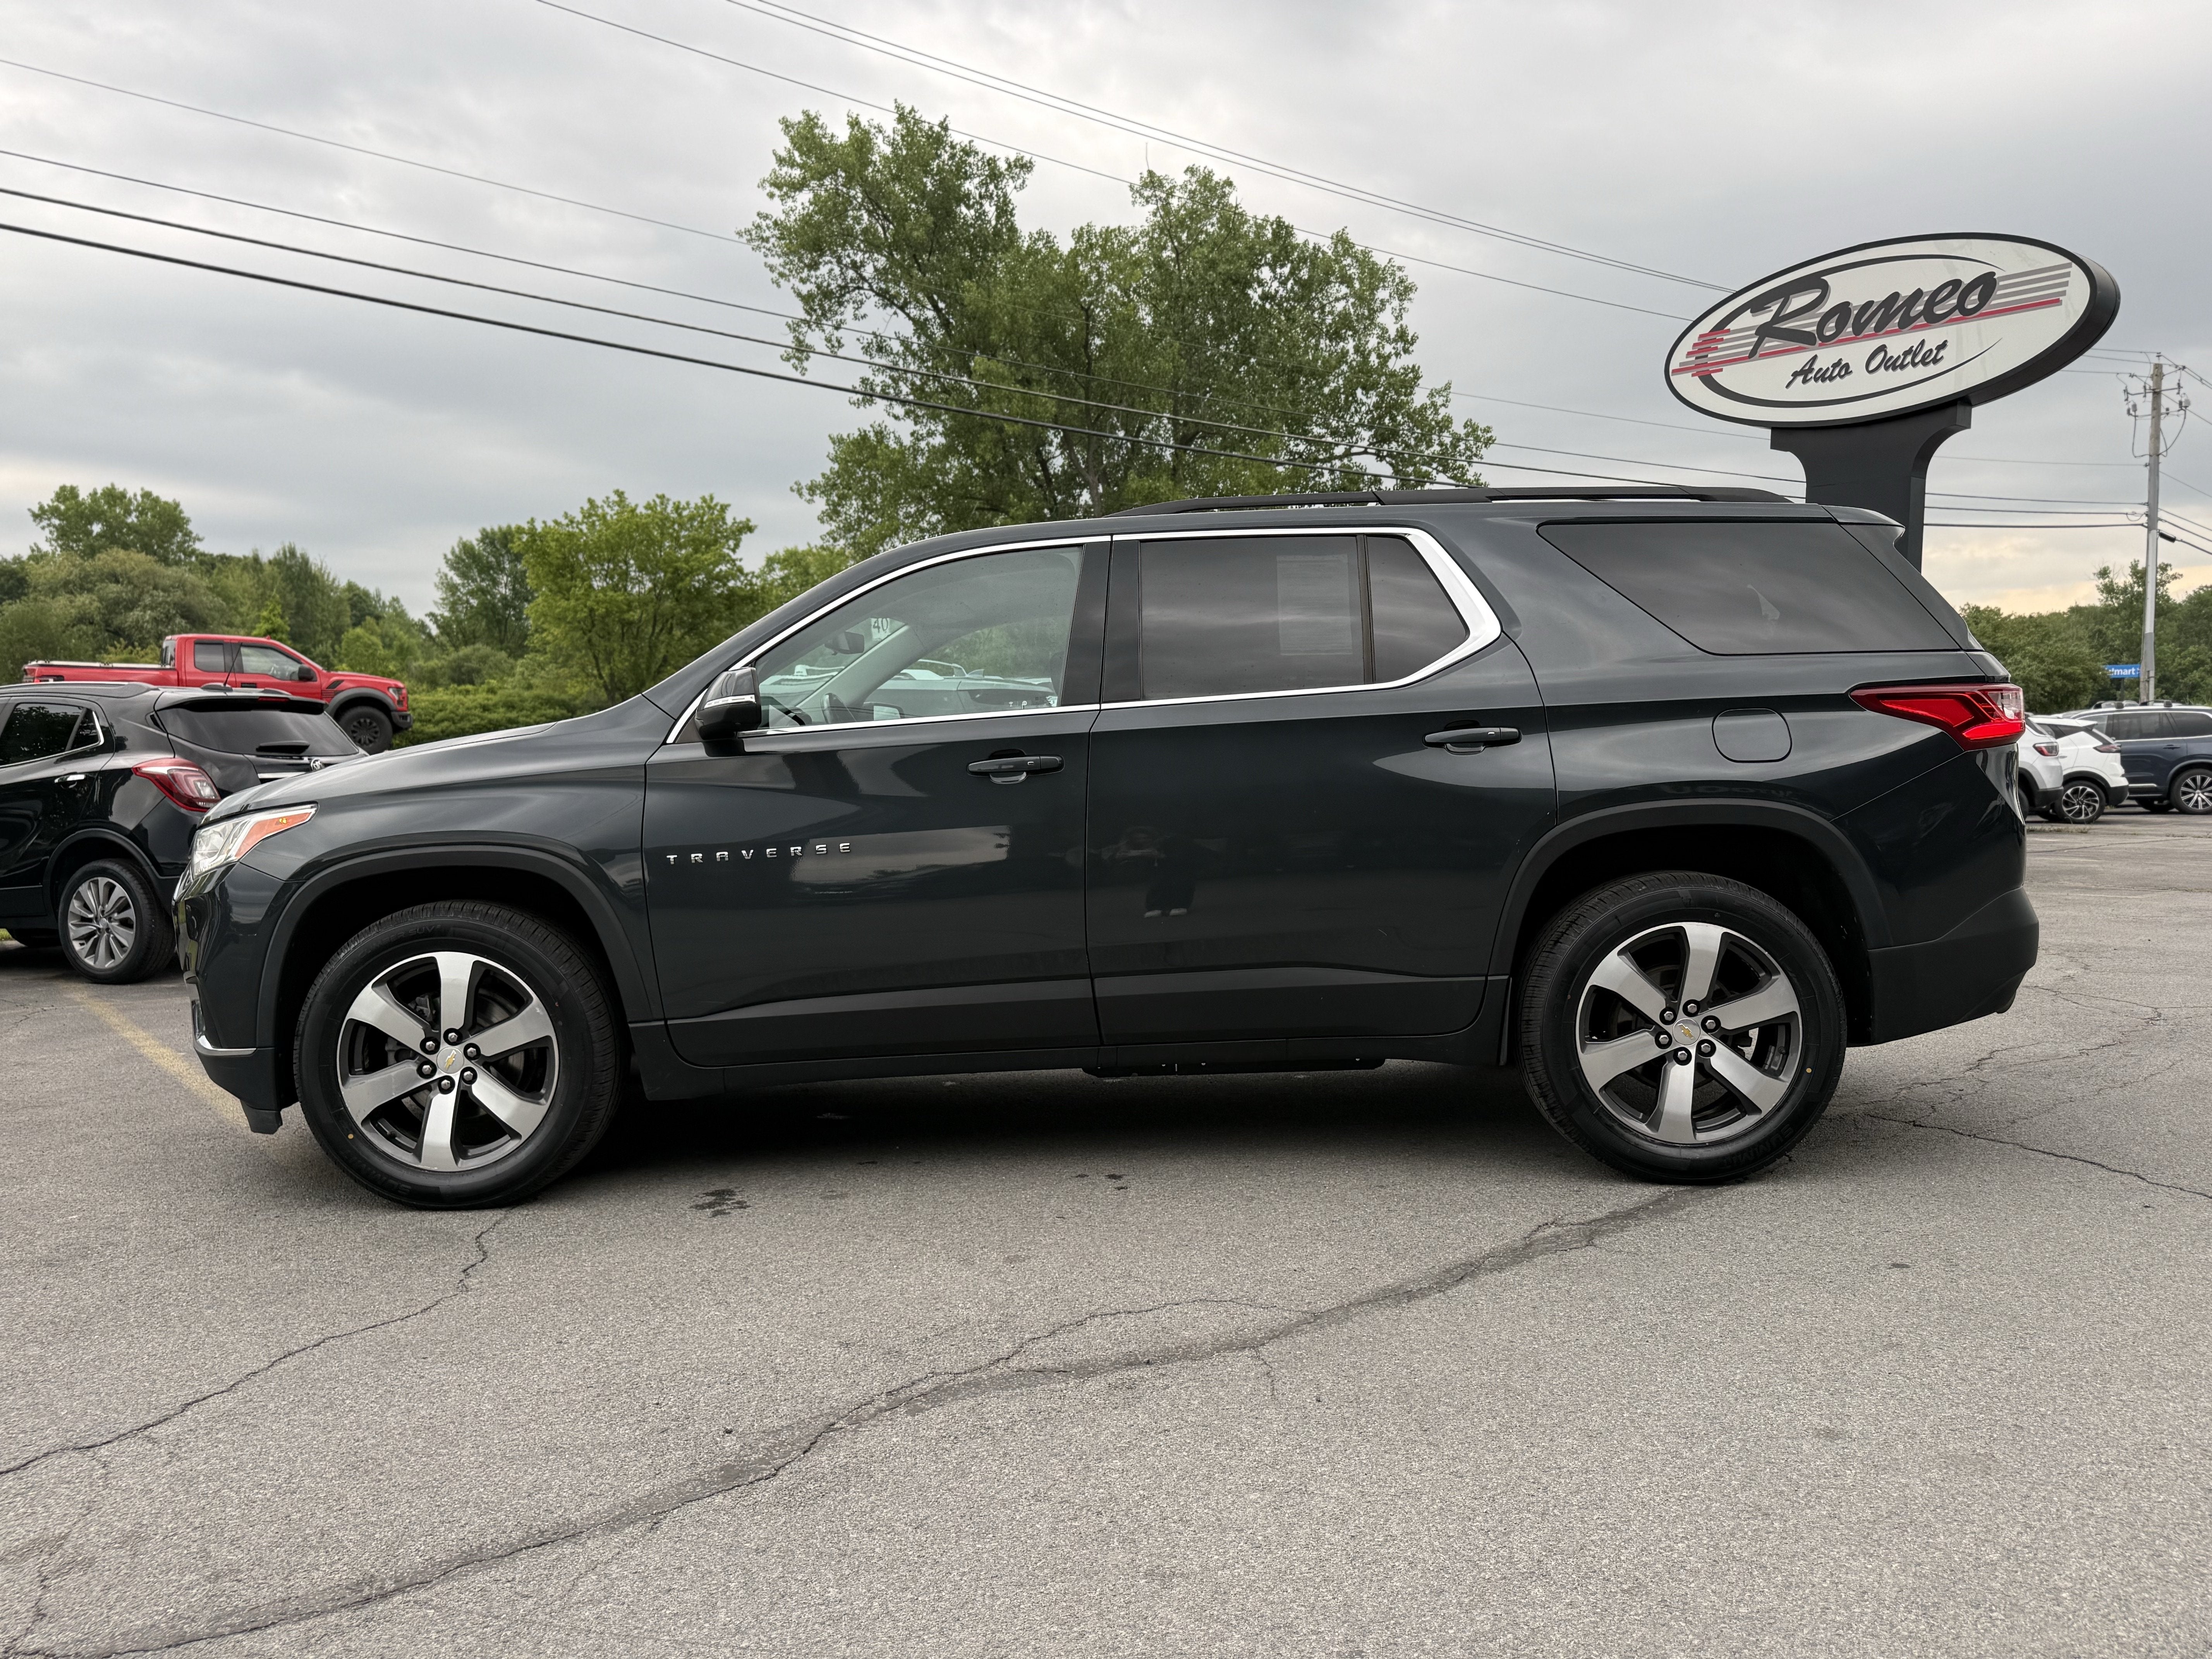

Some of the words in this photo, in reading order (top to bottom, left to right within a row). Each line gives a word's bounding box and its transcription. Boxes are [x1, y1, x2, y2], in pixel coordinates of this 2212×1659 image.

[1748, 271, 1997, 359] Romeo
[1785, 354, 1853, 389] Auto
[1865, 338, 1948, 374] Outlet
[666, 842, 851, 865] TRAVERSE
